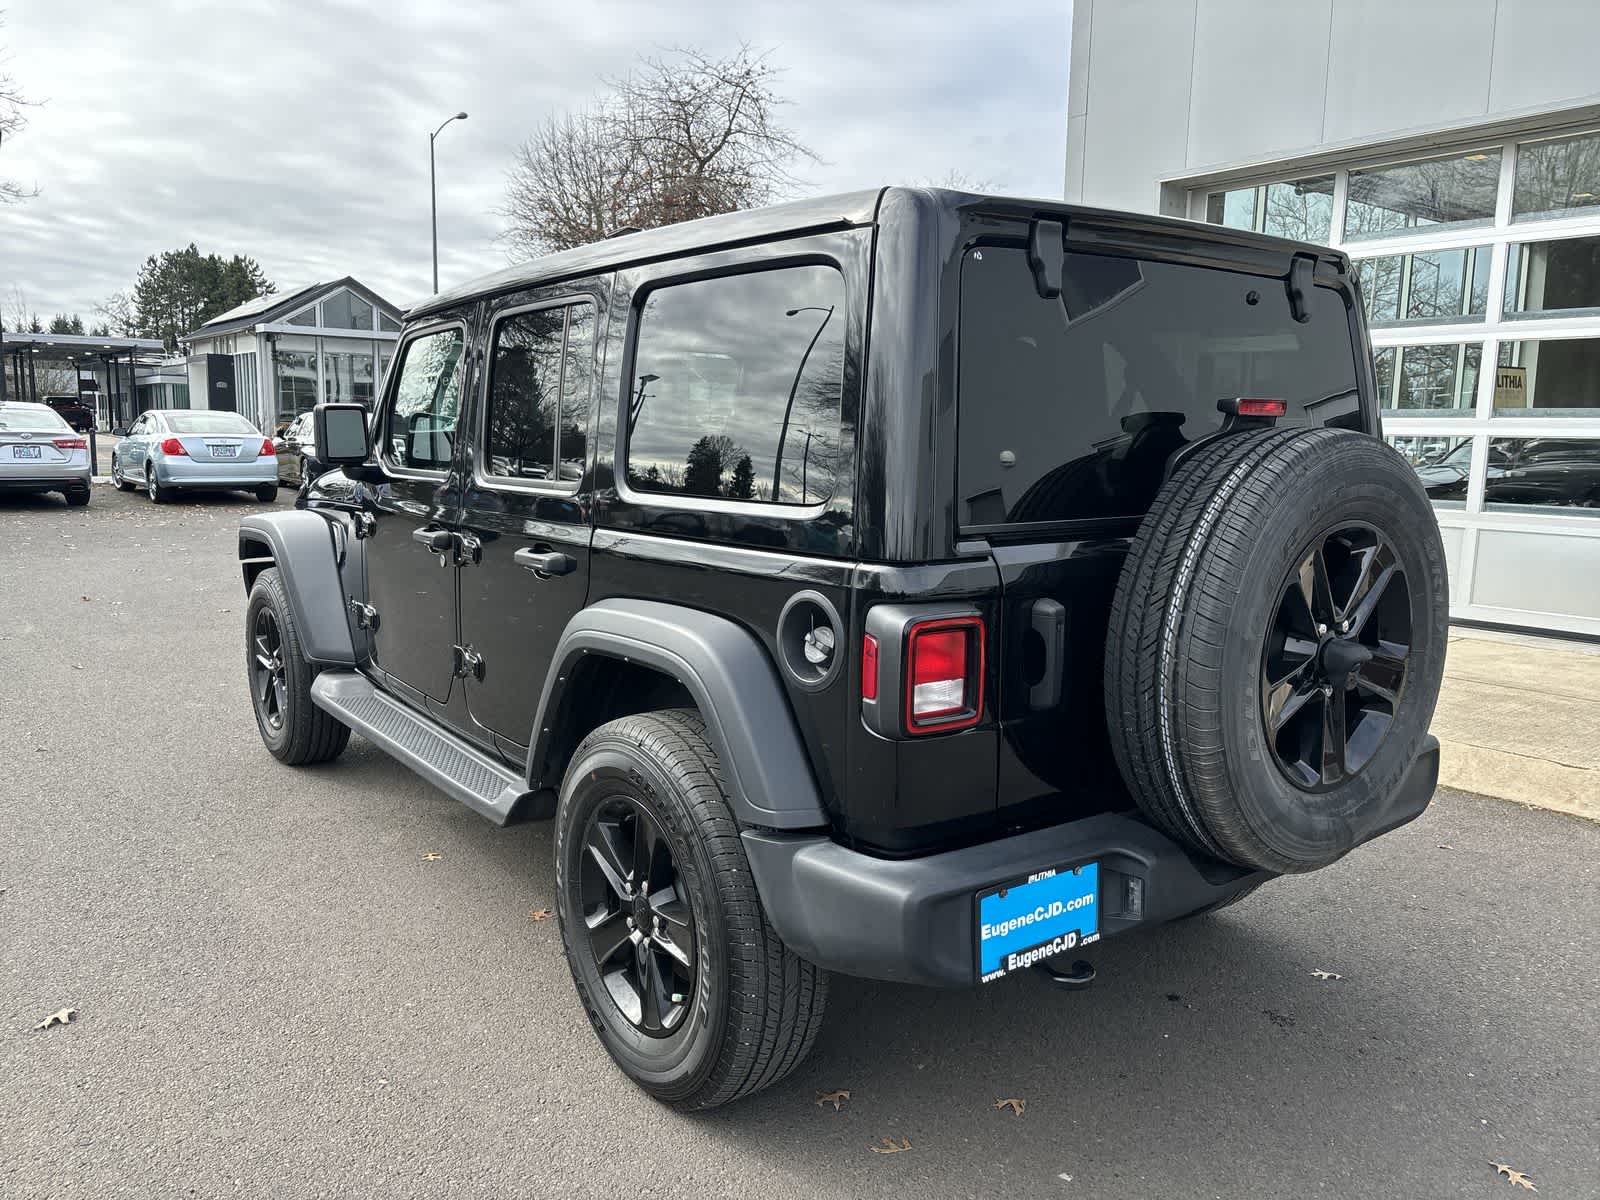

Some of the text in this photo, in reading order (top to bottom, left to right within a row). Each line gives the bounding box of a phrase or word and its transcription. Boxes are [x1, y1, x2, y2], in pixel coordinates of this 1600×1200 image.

[1496, 374, 1523, 389] LITHIA
[1034, 868, 1056, 881] LITHIA
[981, 892, 1094, 940] EugeneCJD.com
[1007, 931, 1077, 971] EugeneCJD
